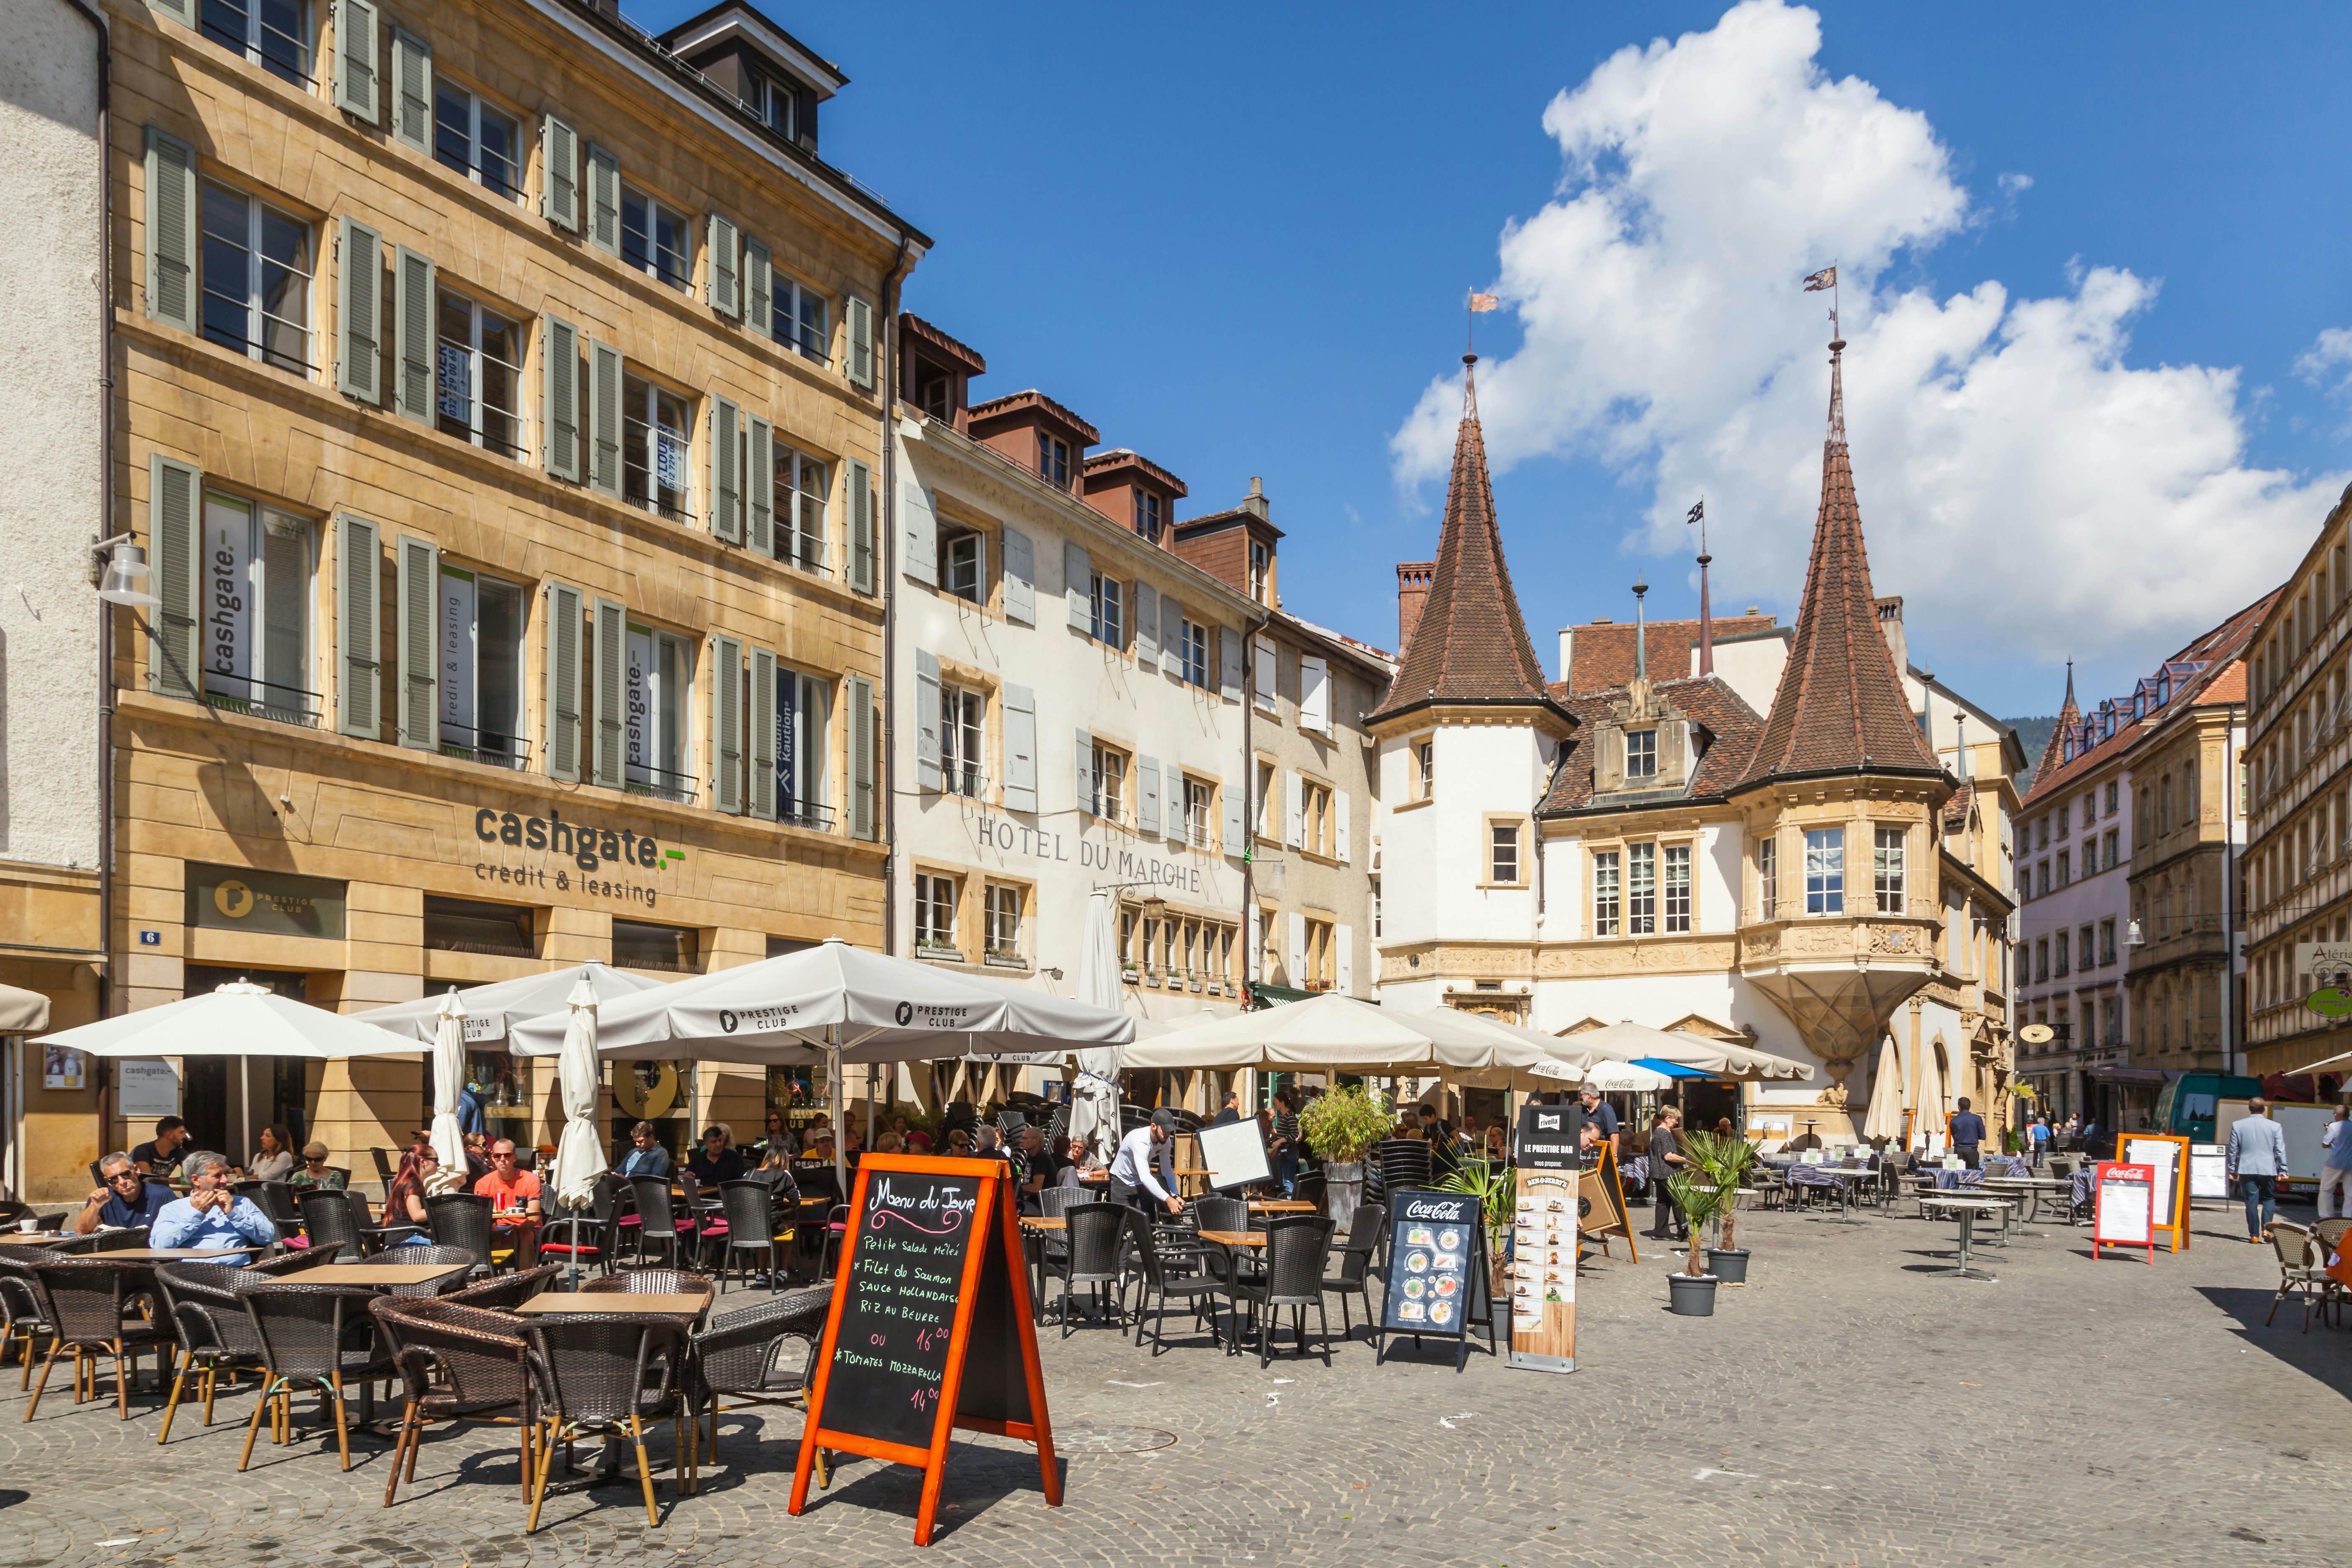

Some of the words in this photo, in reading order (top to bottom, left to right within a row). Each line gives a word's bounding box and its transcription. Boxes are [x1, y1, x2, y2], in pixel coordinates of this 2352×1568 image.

[449, 348, 456, 361] 65
[449, 363, 456, 376] 00
[658, 425, 668, 472] LOUER
[446, 597, 460, 654] leasing
[447, 662, 457, 671] &
[446, 678, 457, 725] credit
[978, 817, 1069, 861] HOTEL
[1081, 840, 1109, 870] DU
[1118, 851, 1199, 893] MARCHE
[476, 863, 545, 888] credit
[557, 871, 570, 891] &
[581, 873, 656, 907] leasing
[257, 894, 315, 906] PRESTIGE
[272, 904, 302, 913] CLUB
[146, 932, 154, 943] 6
[740, 1005, 799, 1019] PRESTIGE
[918, 1006, 967, 1016] PRESTIGE
[461, 1019, 490, 1028] ESTIGE
[758, 1018, 787, 1029] CLUB
[929, 1018, 955, 1027] CLUB
[1532, 1145, 1560, 1153] PRESTIGE
[1561, 1145, 1573, 1154] BAR
[870, 1177, 915, 1211] Menu
[920, 1186, 939, 1209] du
[864, 1236, 896, 1250] Petite
[864, 1259, 889, 1274] Filet
[915, 1268, 951, 1284] Saumon
